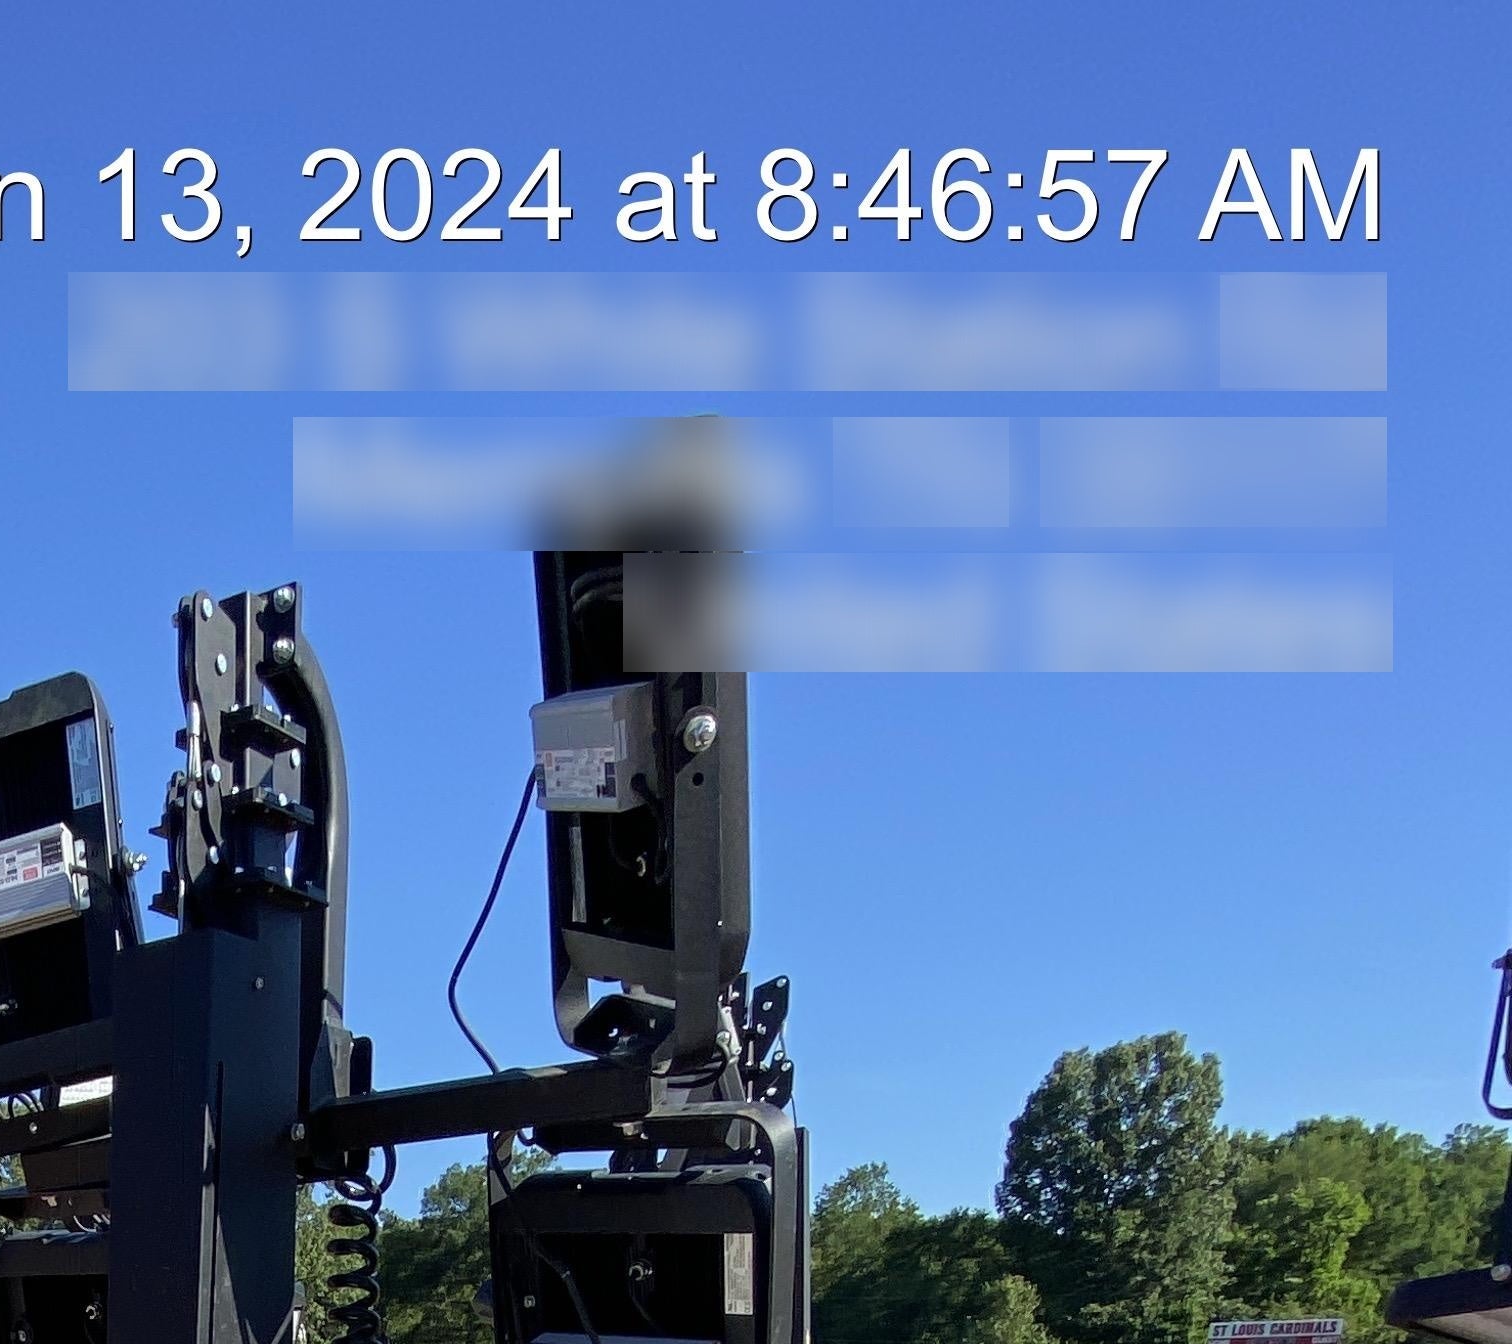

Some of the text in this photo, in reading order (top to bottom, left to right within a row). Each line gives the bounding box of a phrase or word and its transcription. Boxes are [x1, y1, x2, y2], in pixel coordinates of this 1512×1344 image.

[1213, 1321, 1337, 1336] ST LOUIS CARDINALS
